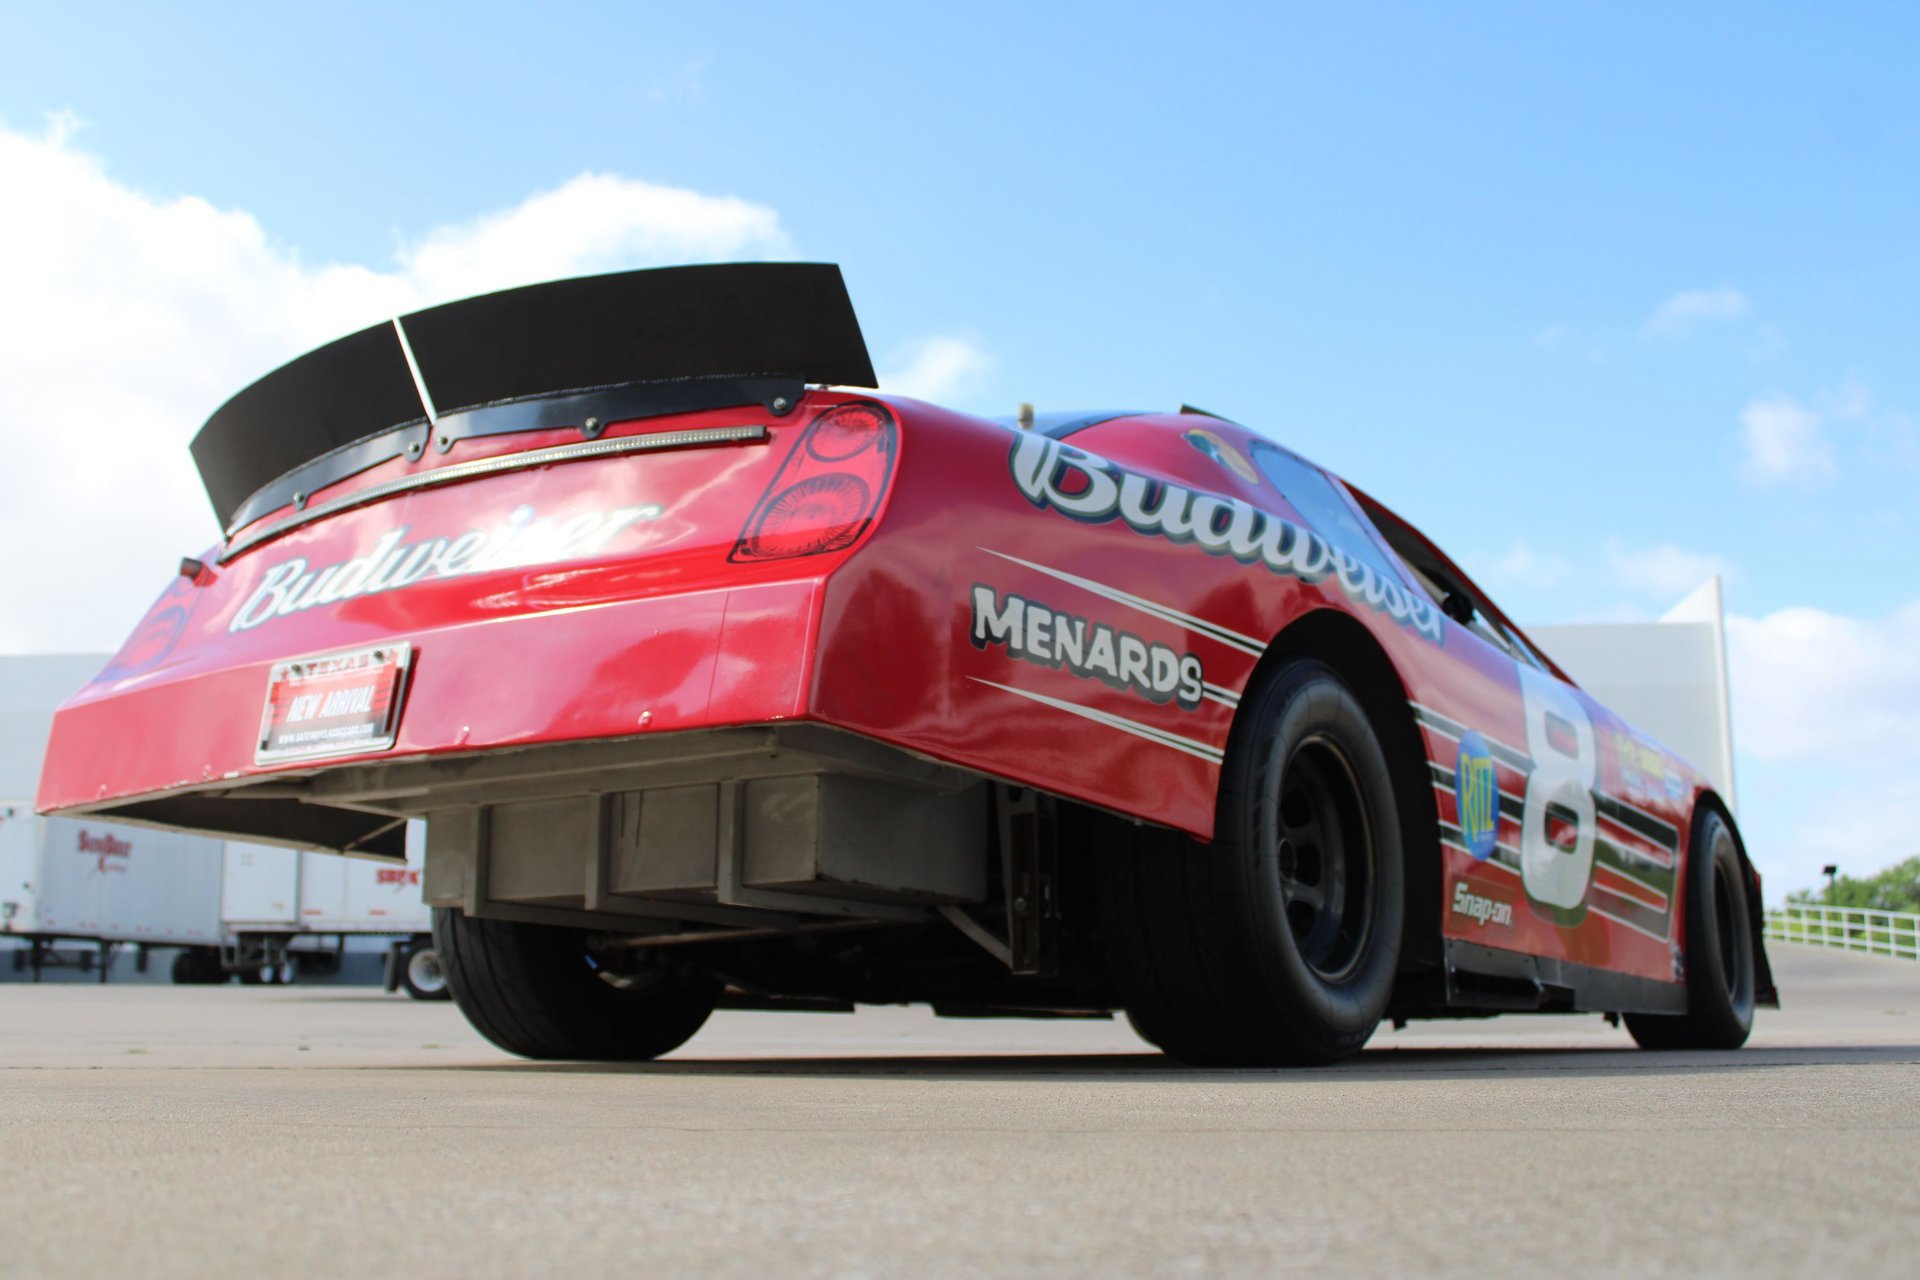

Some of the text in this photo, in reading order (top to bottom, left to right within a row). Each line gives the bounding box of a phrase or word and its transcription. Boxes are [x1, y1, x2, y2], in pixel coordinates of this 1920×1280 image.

[228, 504, 664, 633] Budweiser
[1009, 430, 1444, 646] Budweiser
[307, 655, 369, 676] TEXAS
[970, 584, 1203, 708] MENARDS
[286, 686, 375, 722] NEW ARRIVAL
[1460, 752, 1495, 842] RITZ
[1518, 662, 1597, 920] 8
[1452, 882, 1512, 926] Snap-on
